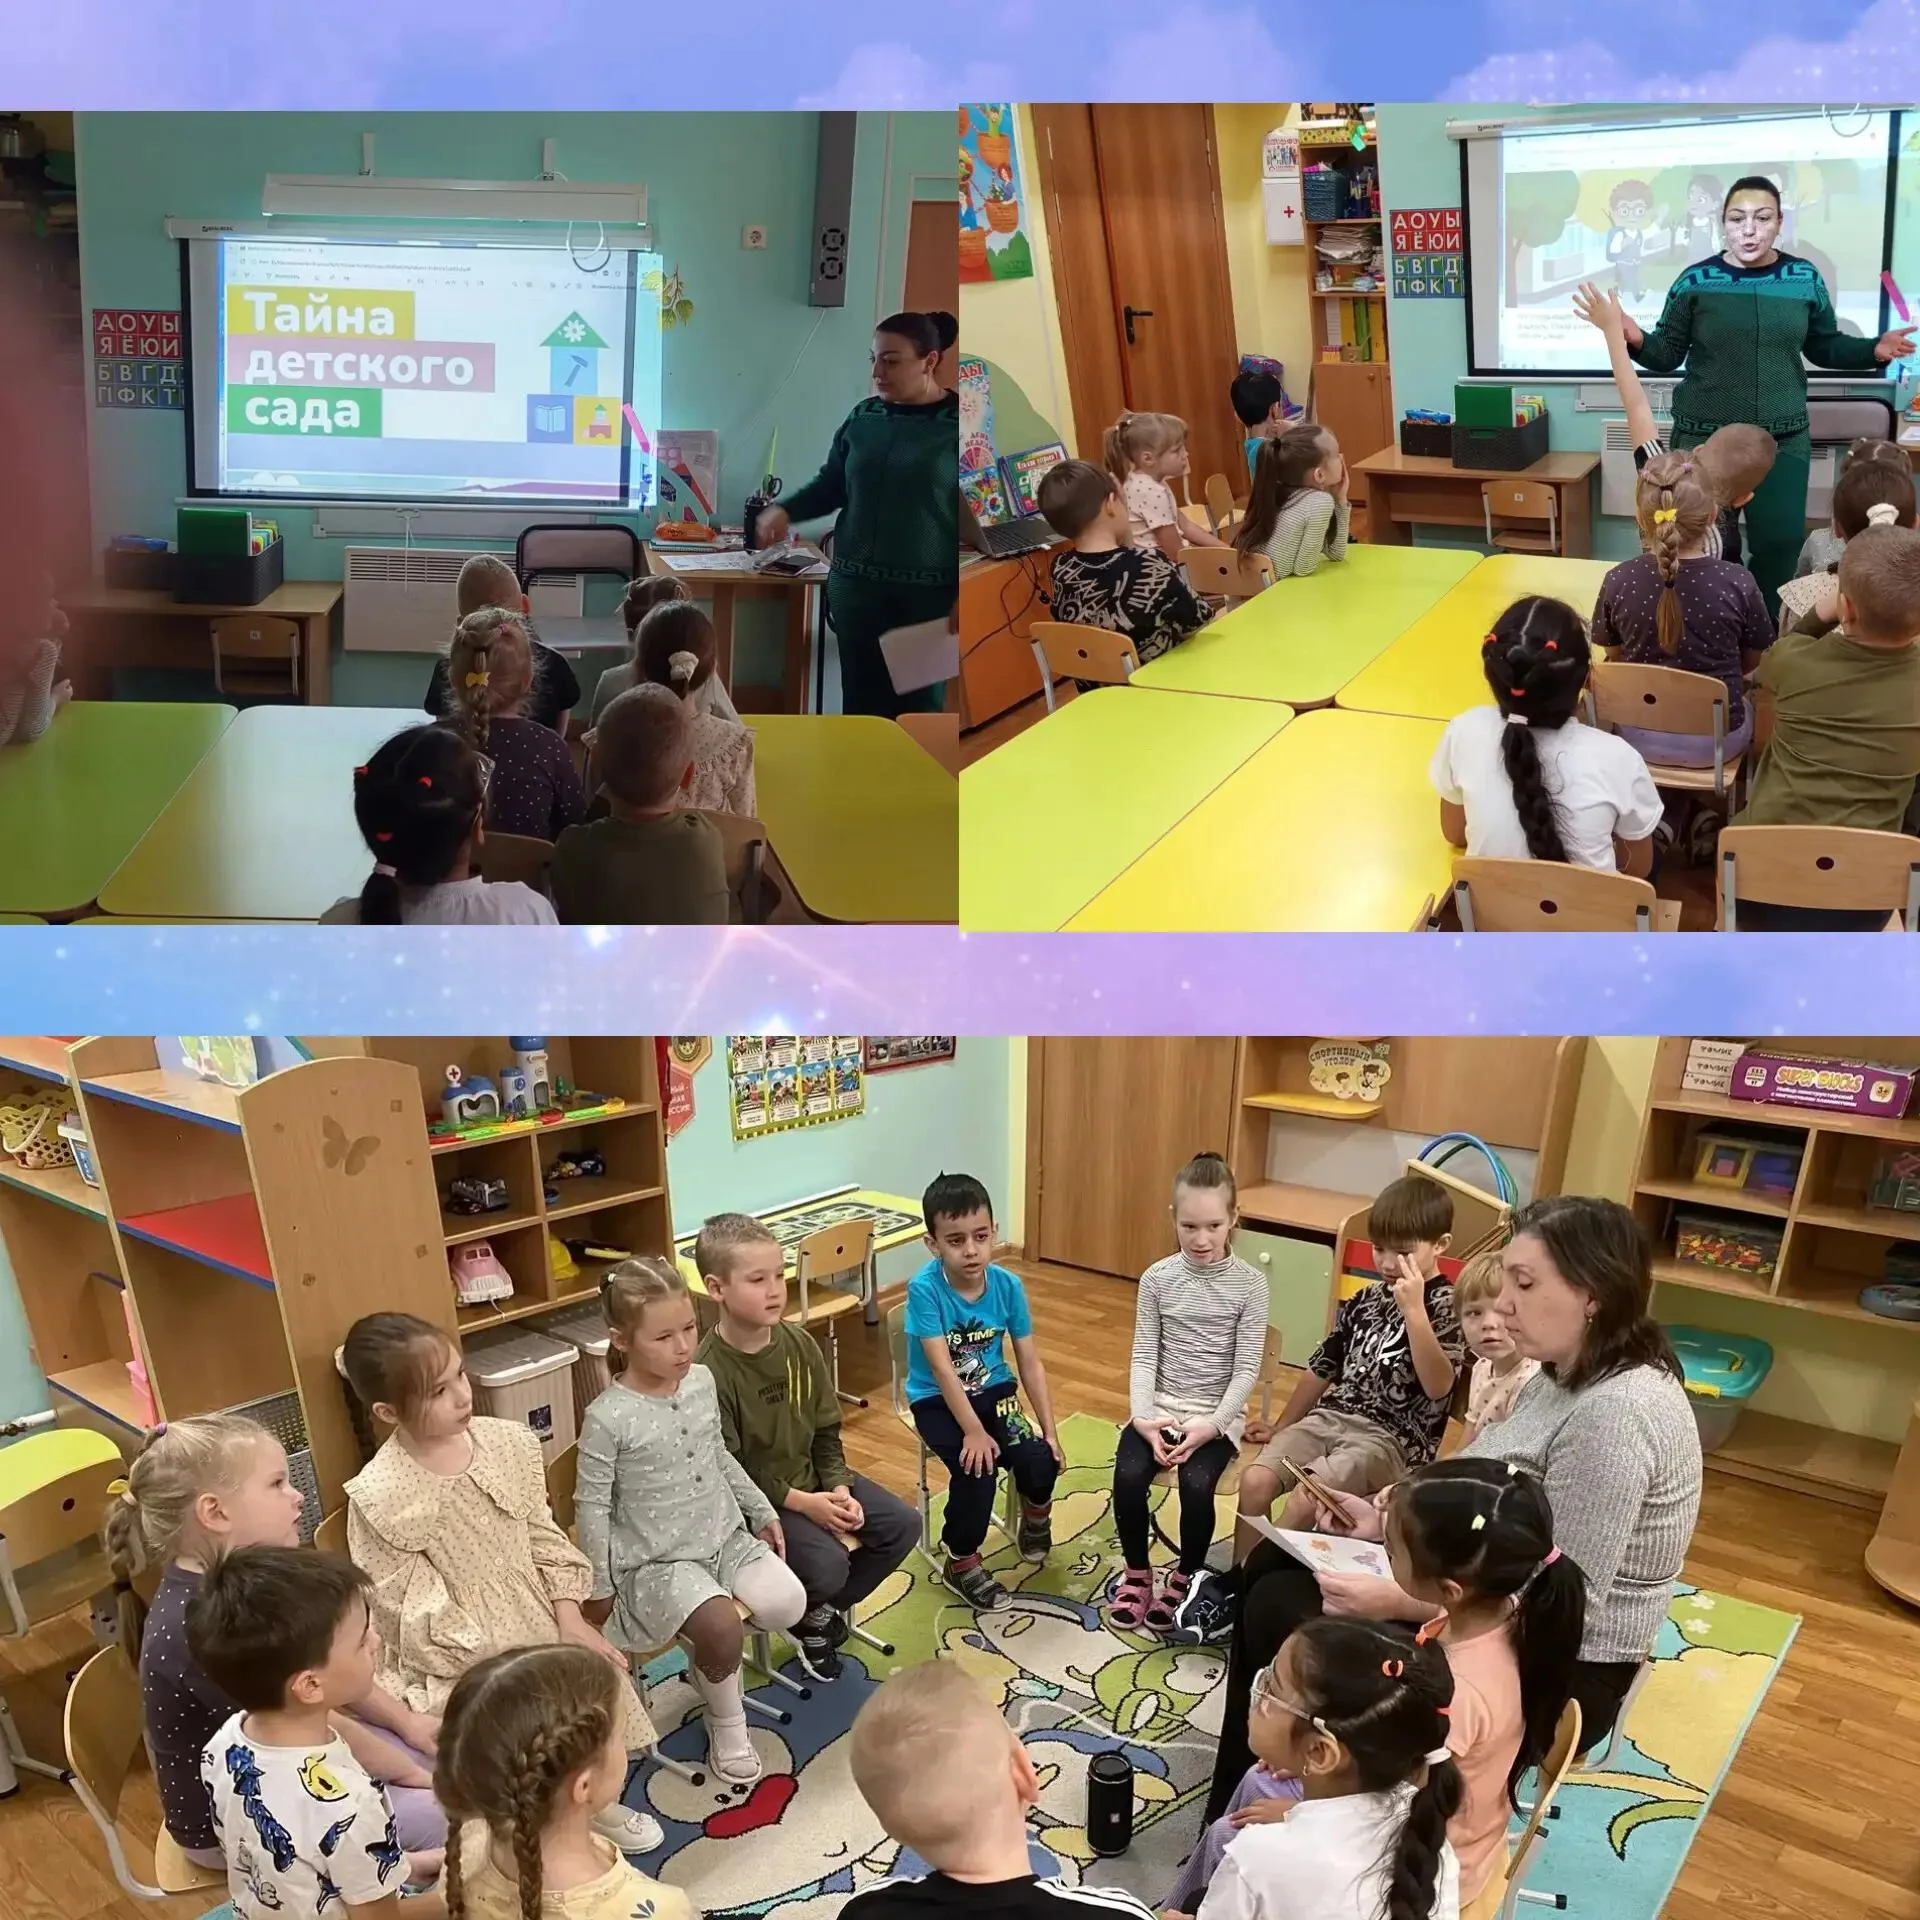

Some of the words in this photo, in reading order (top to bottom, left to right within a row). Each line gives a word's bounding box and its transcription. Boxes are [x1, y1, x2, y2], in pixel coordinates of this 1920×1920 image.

[243, 292, 395, 336] Тайна
[244, 349, 475, 386] детского
[245, 396, 361, 434] сада
[967, 1328, 996, 1342] TIME
